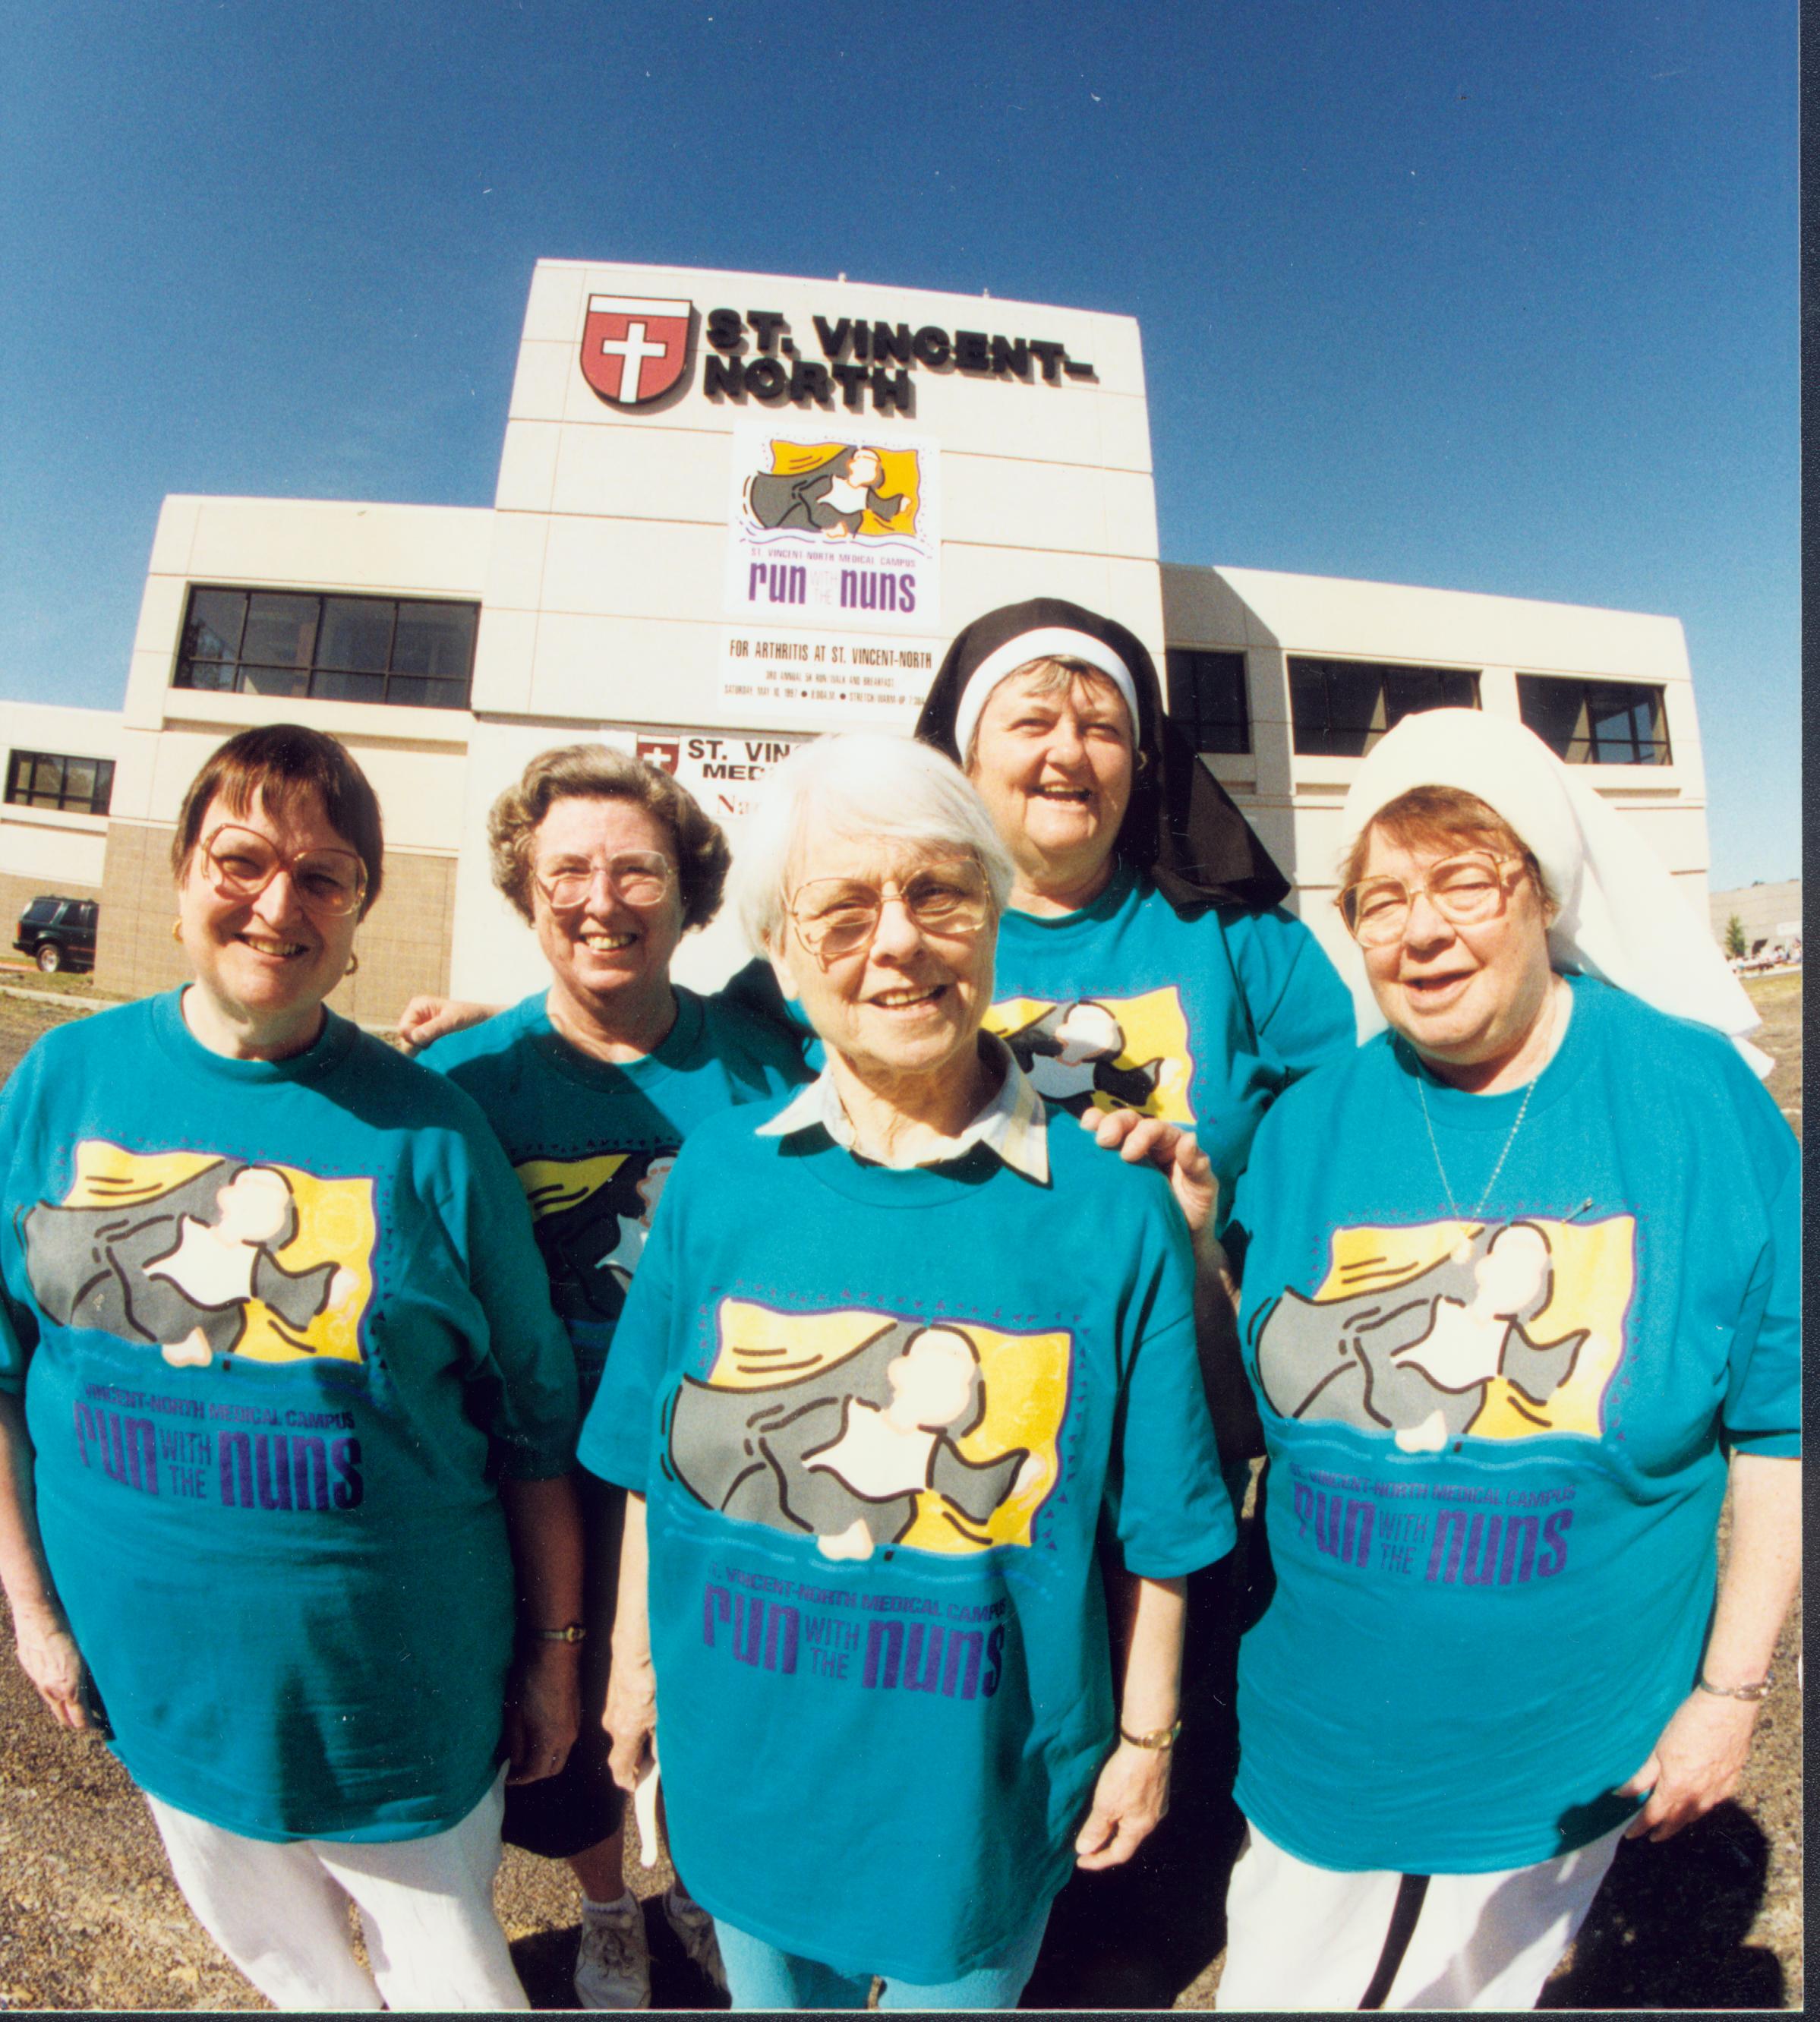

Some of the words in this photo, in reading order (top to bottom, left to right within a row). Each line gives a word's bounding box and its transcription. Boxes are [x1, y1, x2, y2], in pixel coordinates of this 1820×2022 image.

[706, 308, 793, 355] ST.
[703, 354, 910, 410] NORTH
[838, 553, 875, 565] MEDICAL
[880, 557, 916, 567] CAMPUS
[749, 562, 806, 605] run
[839, 569, 916, 614] nuns
[730, 639, 749, 658] FOR
[755, 641, 809, 661] ARTHRITIS
[814, 645, 826, 663] AT
[831, 645, 846, 664] ST.
[852, 647, 932, 670] VINCENT-NORTH
[687, 738, 727, 760] ST.
[745, 741, 801, 762] VIN
[209, 1401, 282, 1427] MEDICAL
[285, 1409, 355, 1430] CAMPUS
[74, 1399, 159, 1496] run
[159, 1428, 212, 1466] WITH
[169, 1465, 207, 1500] THE
[218, 1430, 364, 1511] nuns
[1432, 1483, 1503, 1506] MEDICAL
[1506, 1484, 1576, 1508] CAMPUS
[1294, 1481, 1376, 1569] run
[1379, 1510, 1430, 1544] WITH
[1380, 1542, 1418, 1575] THE
[1426, 1509, 1574, 1586] nuns
[861, 1594, 943, 1617] MEDICAL
[704, 1581, 800, 1675] run
[804, 1614, 860, 1651] WITH
[809, 1646, 849, 1680] THE
[862, 1619, 1005, 1700] nuns
